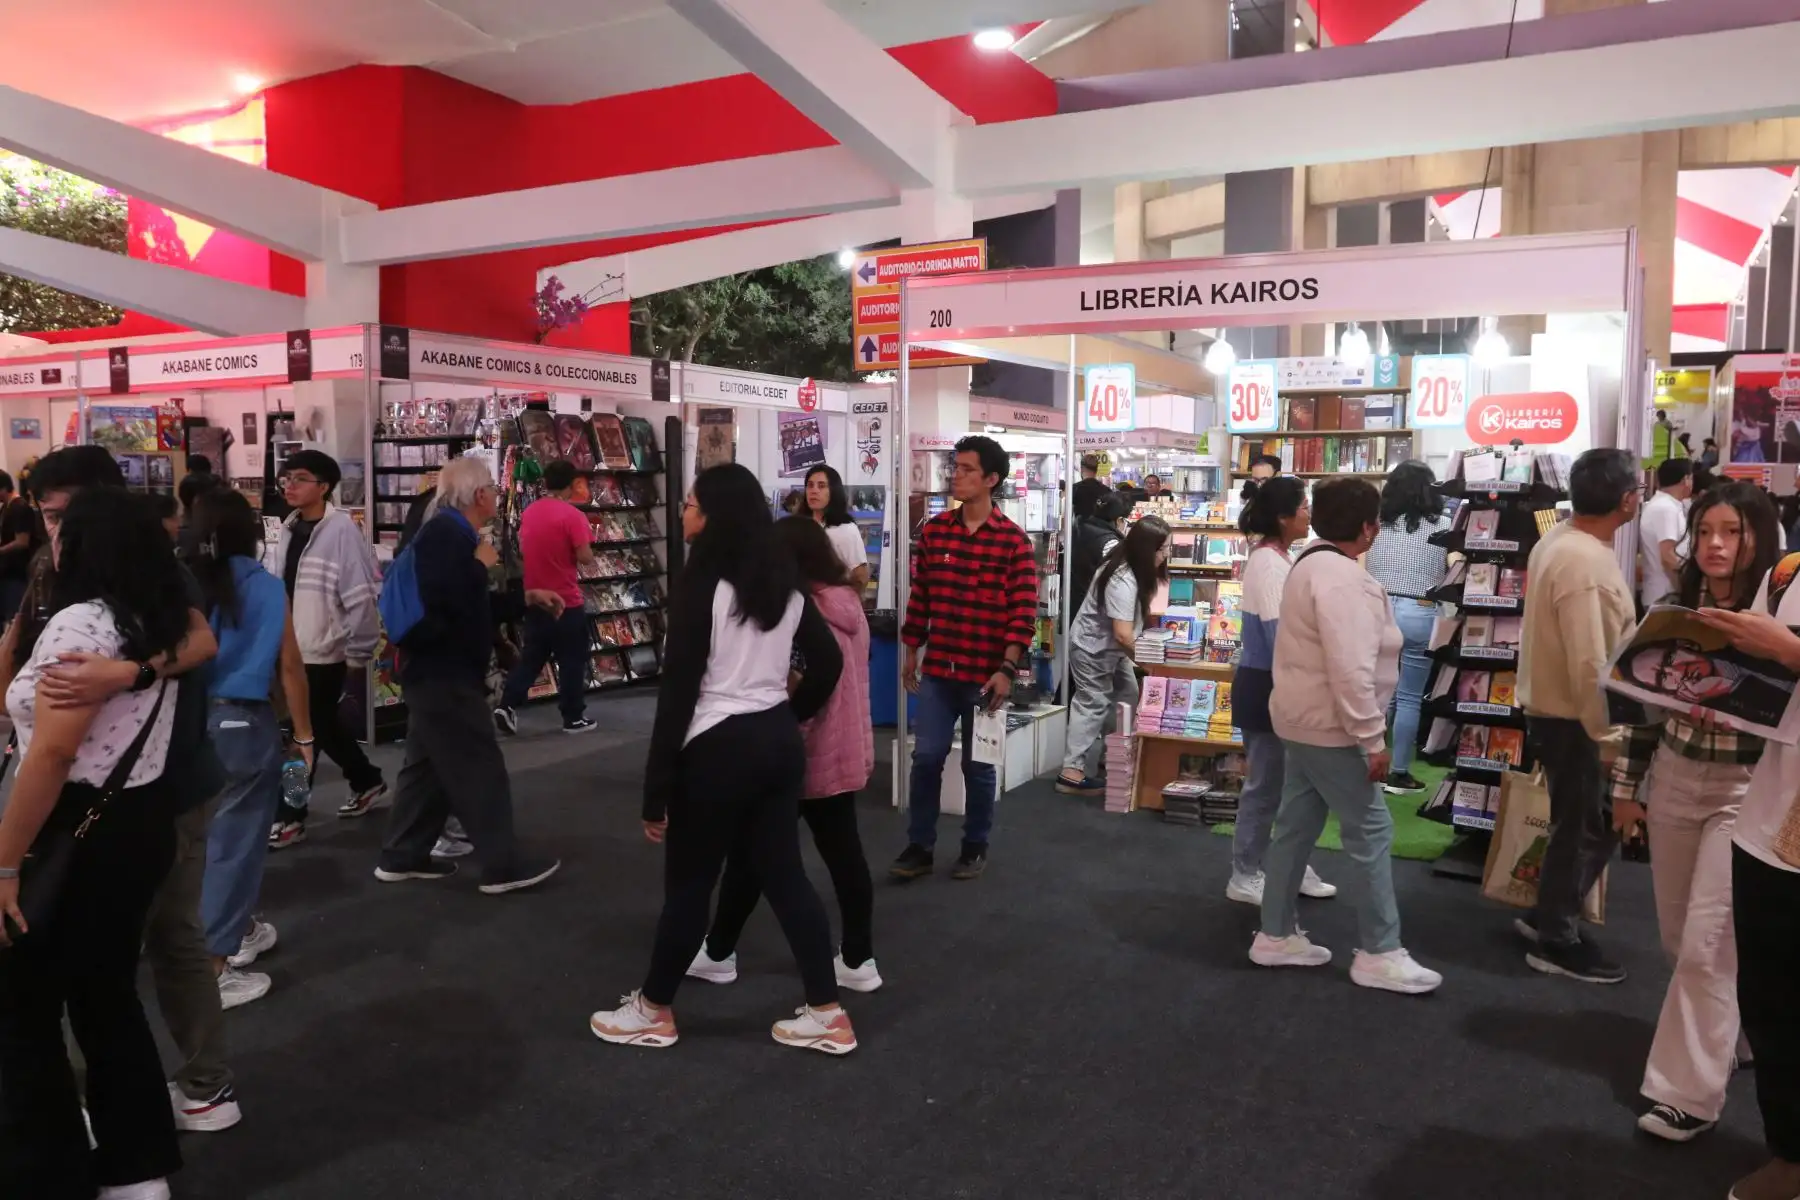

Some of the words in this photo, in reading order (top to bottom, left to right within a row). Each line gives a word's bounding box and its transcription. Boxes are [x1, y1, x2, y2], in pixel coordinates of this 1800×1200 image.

[879, 261, 915, 276] AUDITORIO
[916, 257, 953, 272] CLORINDA
[952, 255, 978, 270] MATTO
[1080, 280, 1203, 311] LIBRERÍA
[1210, 277, 1319, 306] KAIROS
[930, 309, 952, 328] 200
[162, 356, 212, 375] AKABANE
[215, 354, 258, 372] COMICS
[350, 353, 363, 368] 179
[421, 349, 483, 370] AKABANE
[486, 356, 532, 375] COMICS
[535, 362, 542, 376] &
[545, 363, 637, 386] COLECCIONABLES
[0, 372, 35, 386] NABLES
[720, 381, 762, 397] EDITORIAL
[763, 385, 788, 400] CEDET
[1505, 407, 1563, 418] LIBRERÍA
[1505, 417, 1562, 430] Kairos
